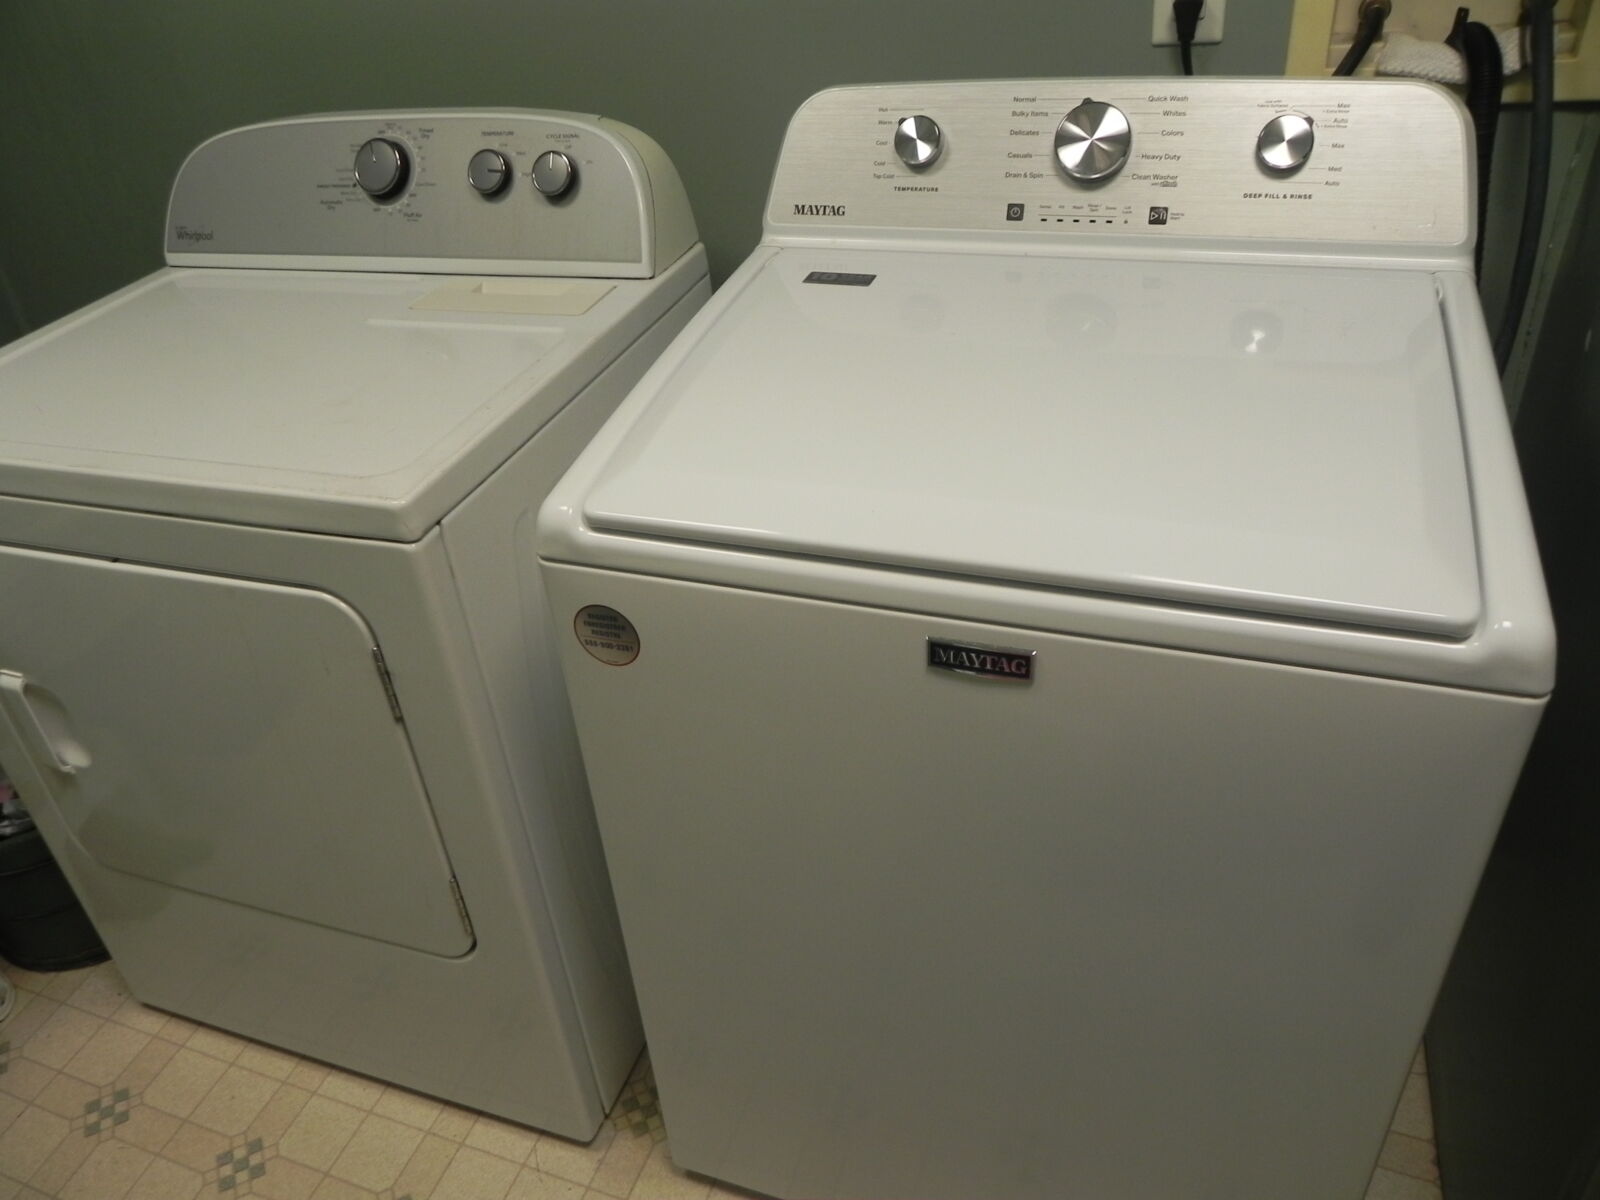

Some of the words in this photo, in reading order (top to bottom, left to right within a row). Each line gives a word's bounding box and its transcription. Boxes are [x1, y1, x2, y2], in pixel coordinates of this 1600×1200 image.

[1011, 110, 1029, 118] Bulky
[1141, 153, 1163, 161] Heavy
[1164, 153, 1181, 161] Duty
[793, 204, 846, 216] MAYTAG
[176, 231, 214, 243] Whirlpool
[935, 646, 1027, 674] MAYTAG
